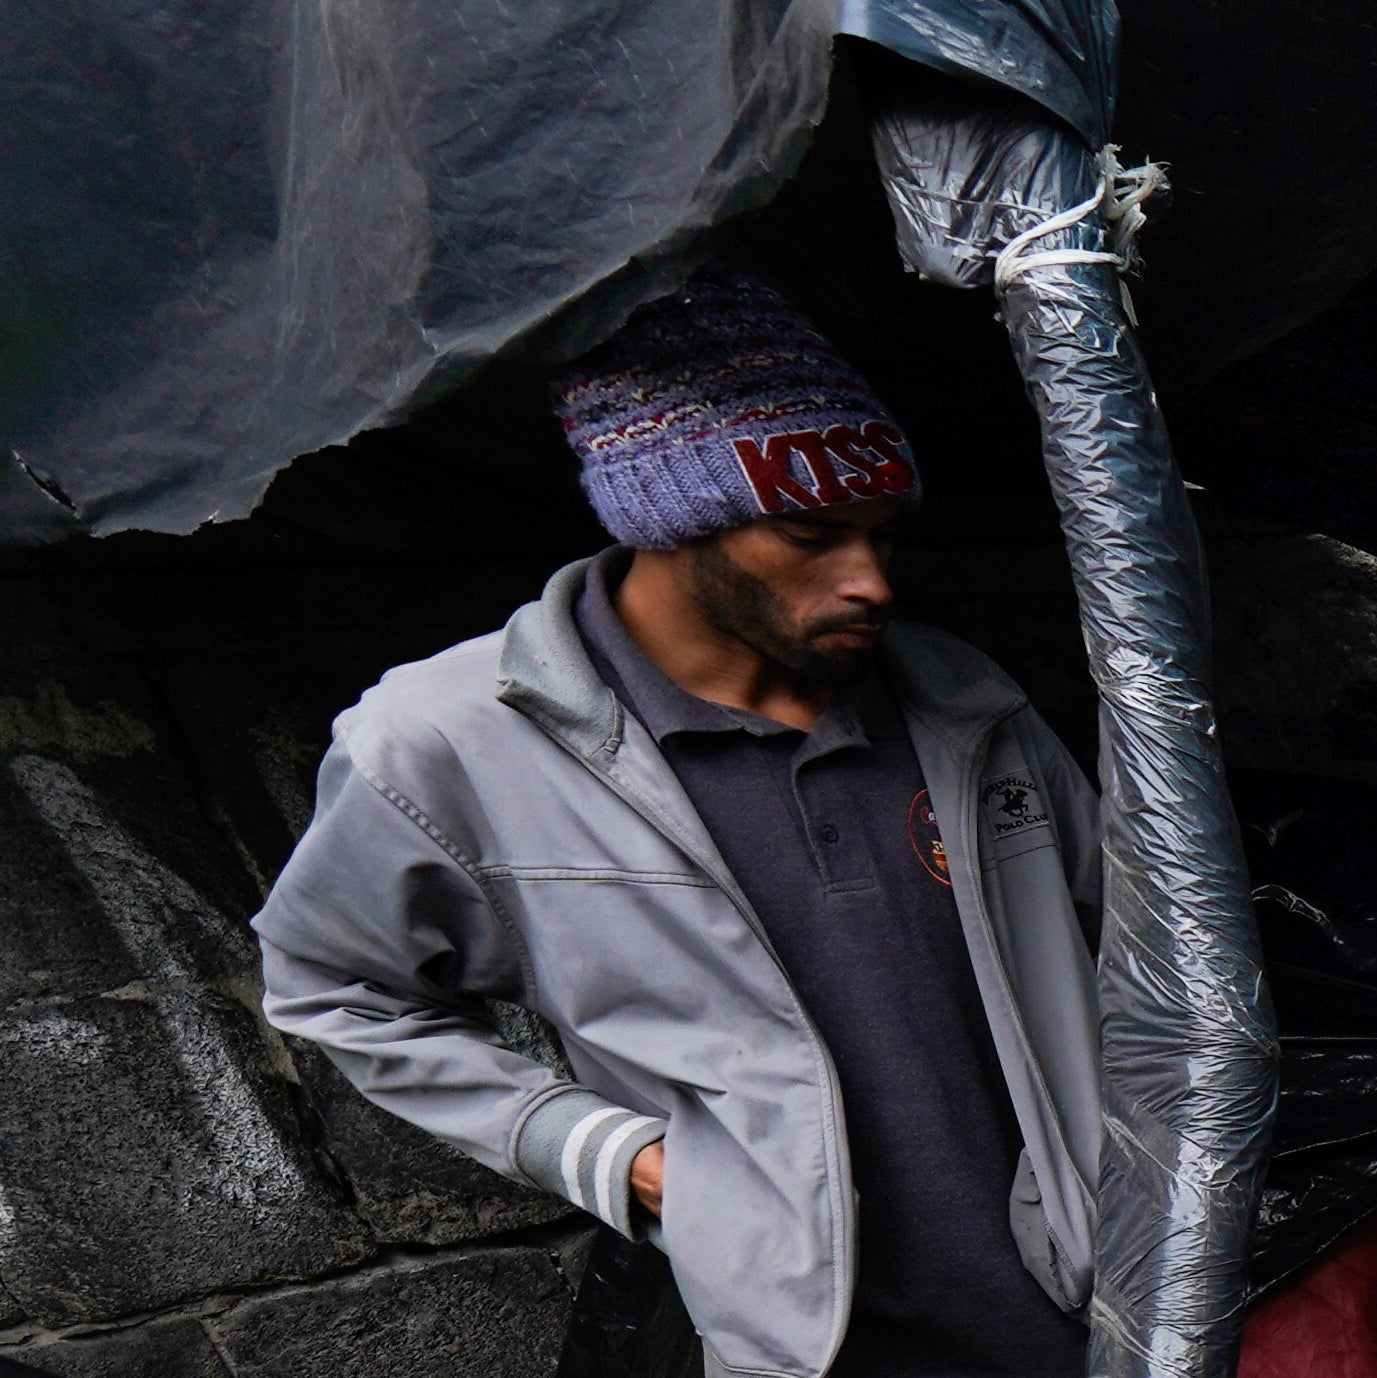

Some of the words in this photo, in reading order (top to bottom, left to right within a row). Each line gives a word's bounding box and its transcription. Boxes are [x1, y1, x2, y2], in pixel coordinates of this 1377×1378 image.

[730, 419, 916, 514] KISS
[994, 819, 1023, 833] POLO
[1024, 813, 1048, 824] CLU
